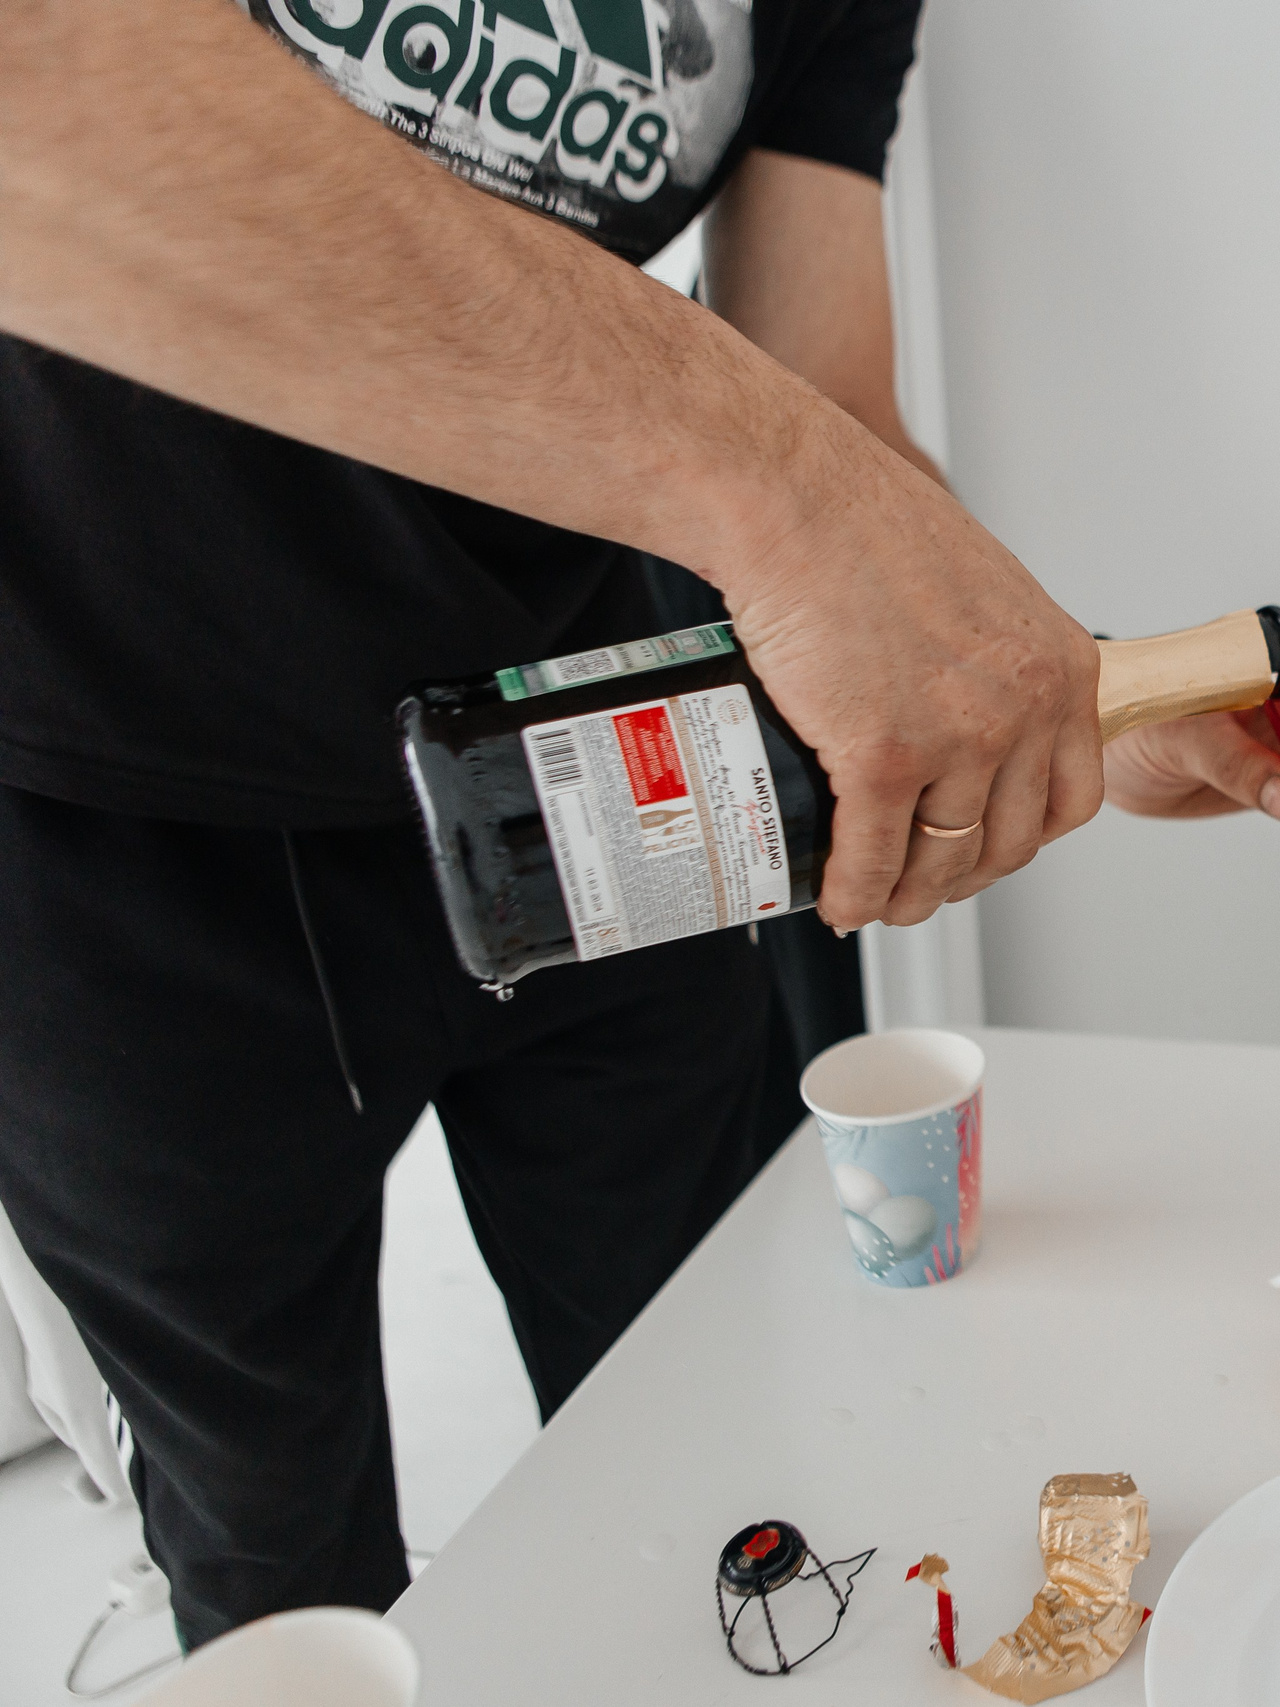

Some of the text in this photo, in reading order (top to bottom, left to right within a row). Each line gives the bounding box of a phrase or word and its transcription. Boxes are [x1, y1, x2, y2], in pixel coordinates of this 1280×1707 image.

[281, 0, 669, 184] adidas
[390, 109, 416, 136] The
[418, 121, 428, 140] 3
[751, 767, 773, 813] SANTO
[763, 817, 783, 870] STEFANO
